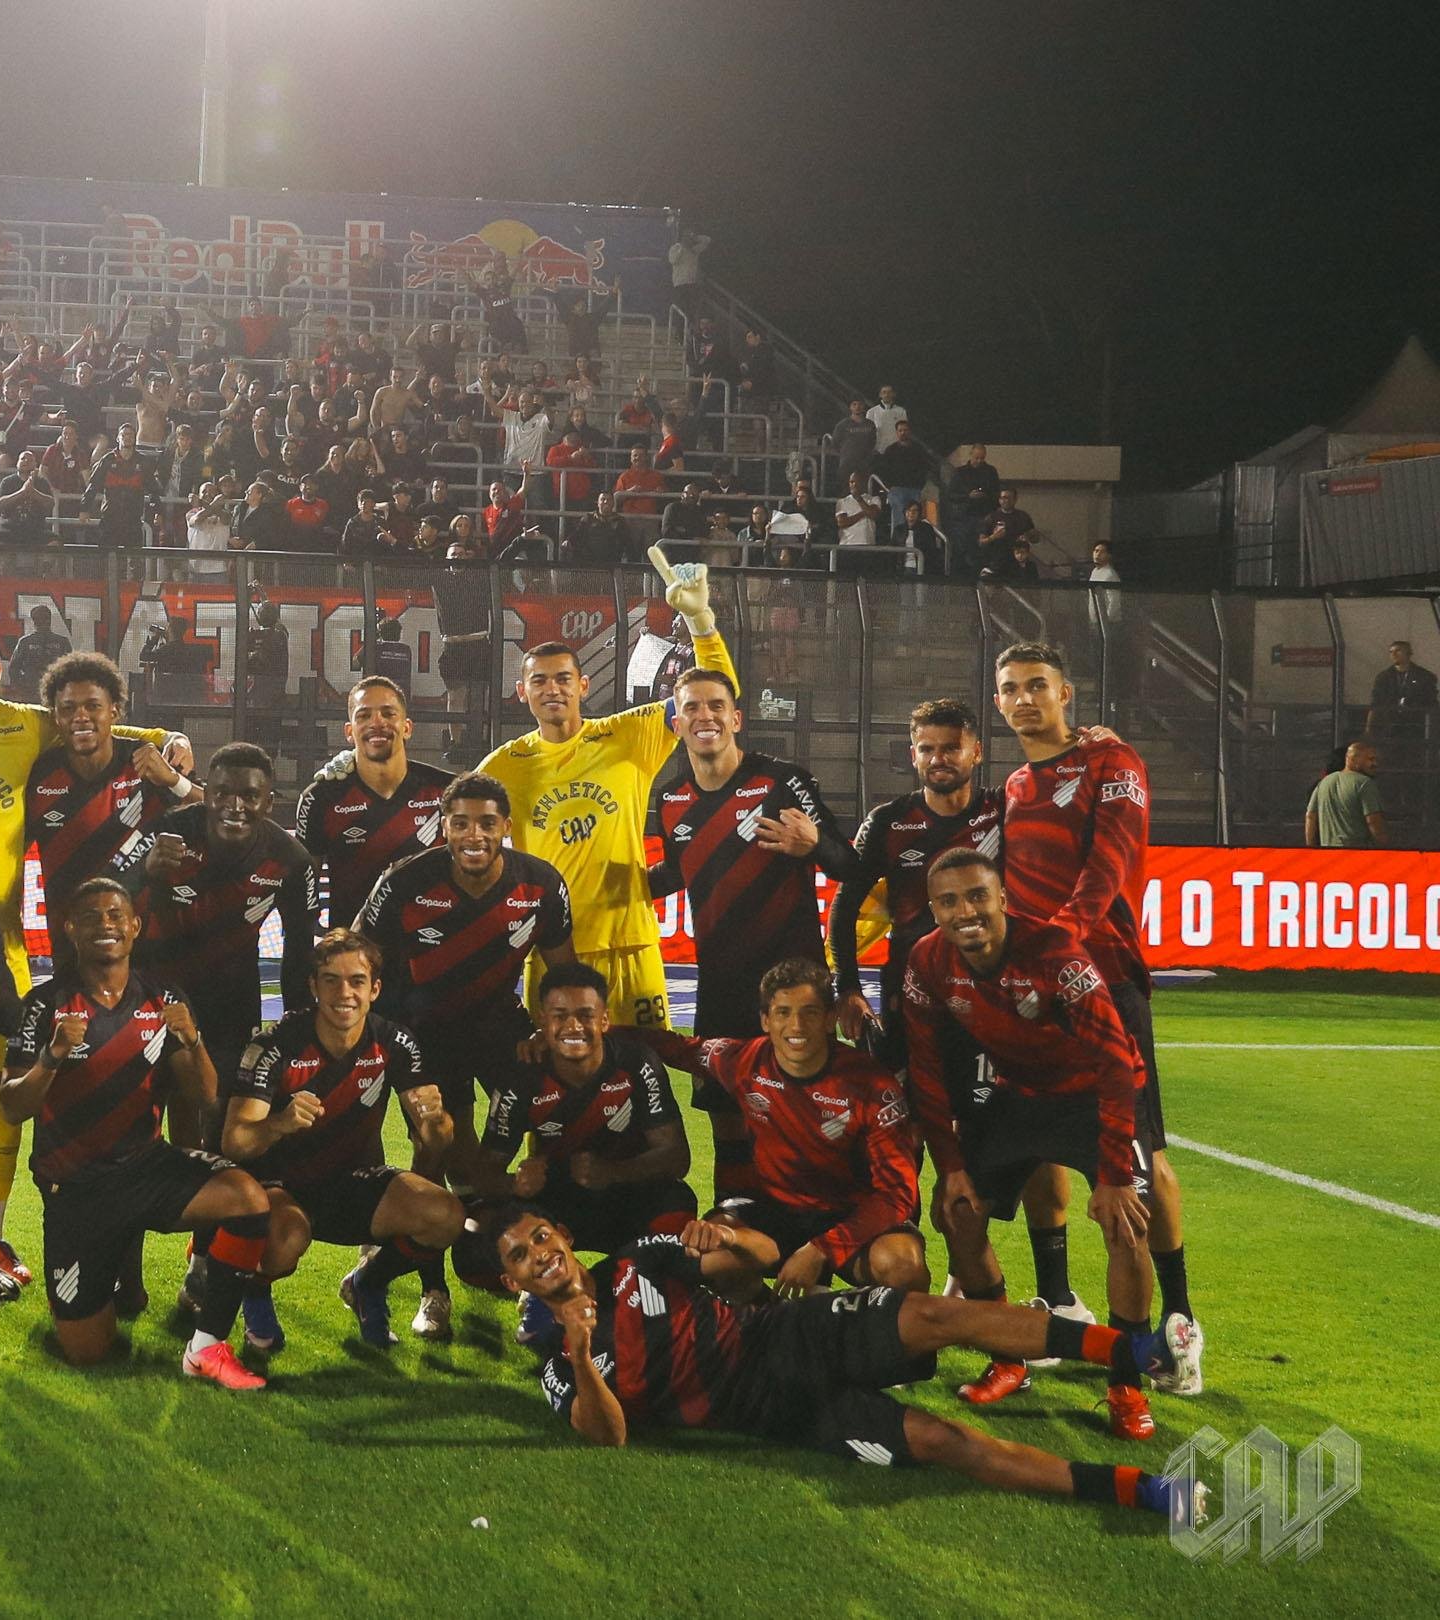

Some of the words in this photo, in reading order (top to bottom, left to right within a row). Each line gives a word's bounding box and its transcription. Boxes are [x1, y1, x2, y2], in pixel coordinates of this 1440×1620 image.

[116, 213, 250, 286] Red
[257, 220, 385, 290] Bull
[36, 785, 70, 796] Copacol
[113, 778, 143, 790] Copacol
[736, 785, 769, 798] Copacol
[408, 797, 441, 810] Copacol
[532, 782, 619, 830] ATHLETICO
[663, 792, 691, 802] Copacol
[786, 775, 822, 826] HAVAN
[1102, 785, 1145, 808] HAVAN
[294, 792, 316, 840] HAVAN
[334, 803, 368, 815] Copacol
[891, 821, 927, 831] Copacol
[250, 874, 283, 888] Copacol
[365, 881, 393, 927] HAVAN
[415, 895, 452, 908] Copacol
[506, 898, 541, 909] Copacol
[1181, 880, 1213, 946] O
[634, 995, 665, 1026] 23
[22, 1000, 46, 1053] HAVAN
[640, 1063, 663, 1115] HAVAN
[813, 1091, 849, 1106] Copacol
[498, 1089, 518, 1137] HAVAN
[637, 1233, 683, 1248] HAVA
[612, 1265, 636, 1297] Copaco
